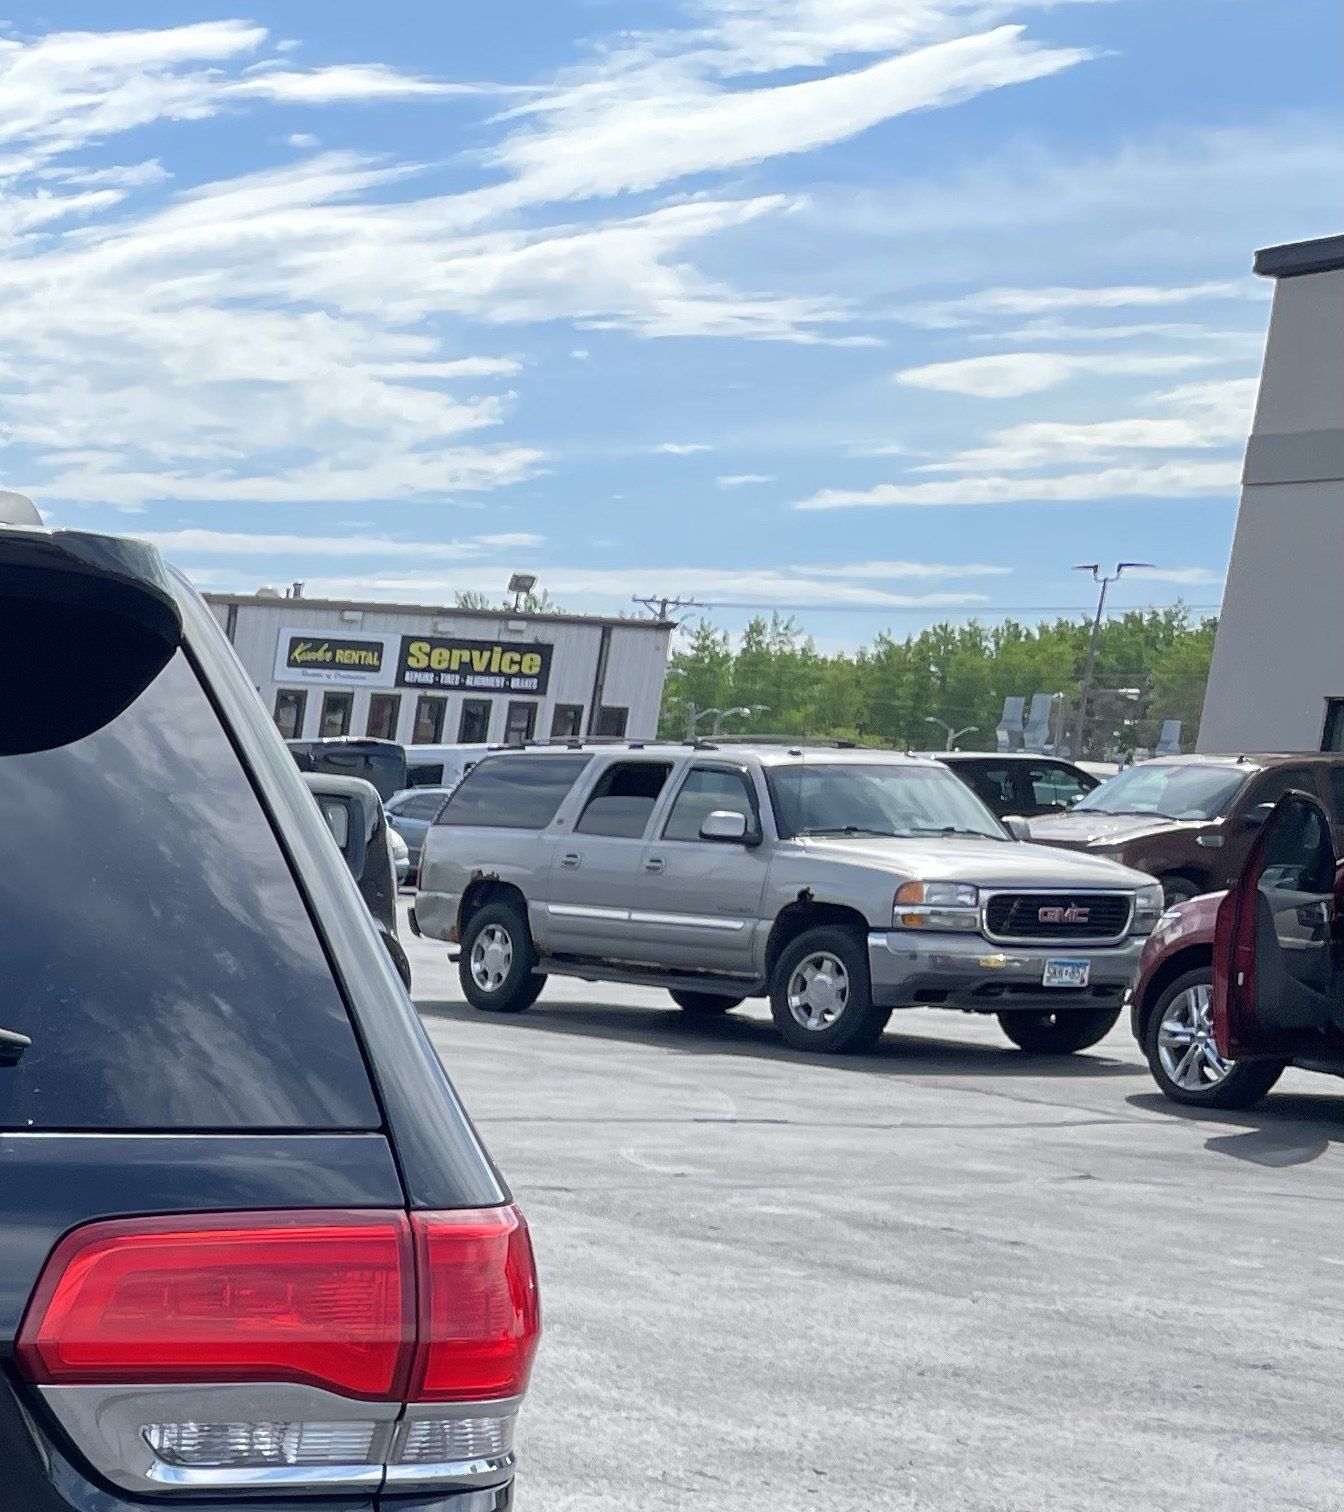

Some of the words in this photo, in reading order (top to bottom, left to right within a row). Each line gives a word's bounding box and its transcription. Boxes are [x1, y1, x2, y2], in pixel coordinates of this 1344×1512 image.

[335, 649, 380, 666] RENTAL
[407, 641, 542, 675] Service
[1038, 906, 1091, 923] GMC
